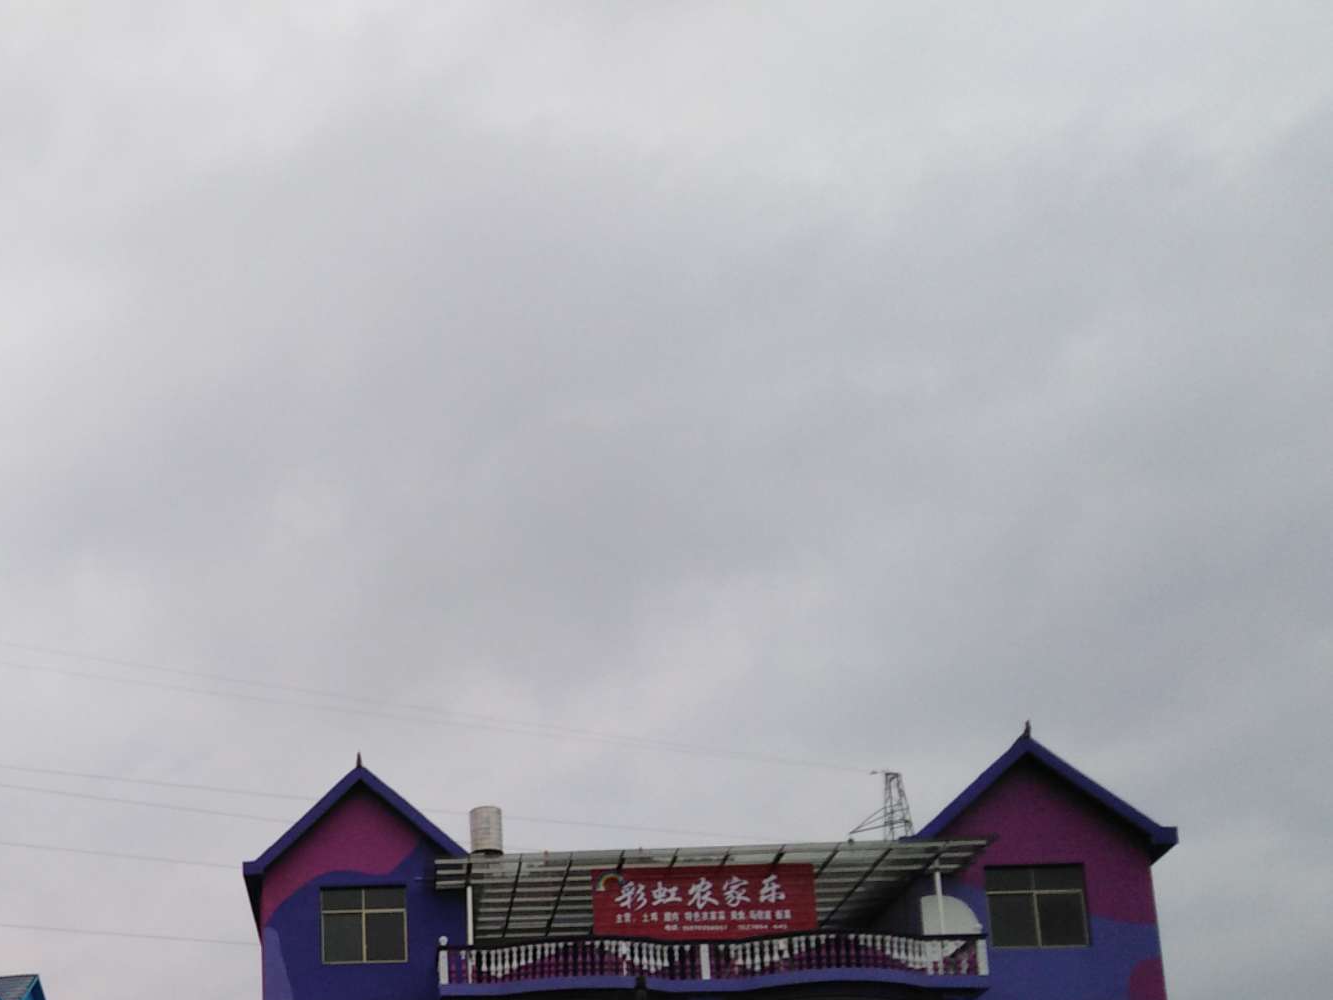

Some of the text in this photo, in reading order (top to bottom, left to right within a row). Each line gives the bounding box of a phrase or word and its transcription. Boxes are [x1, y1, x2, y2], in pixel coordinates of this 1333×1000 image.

[614, 875, 786, 910] 彩虹农家乐
